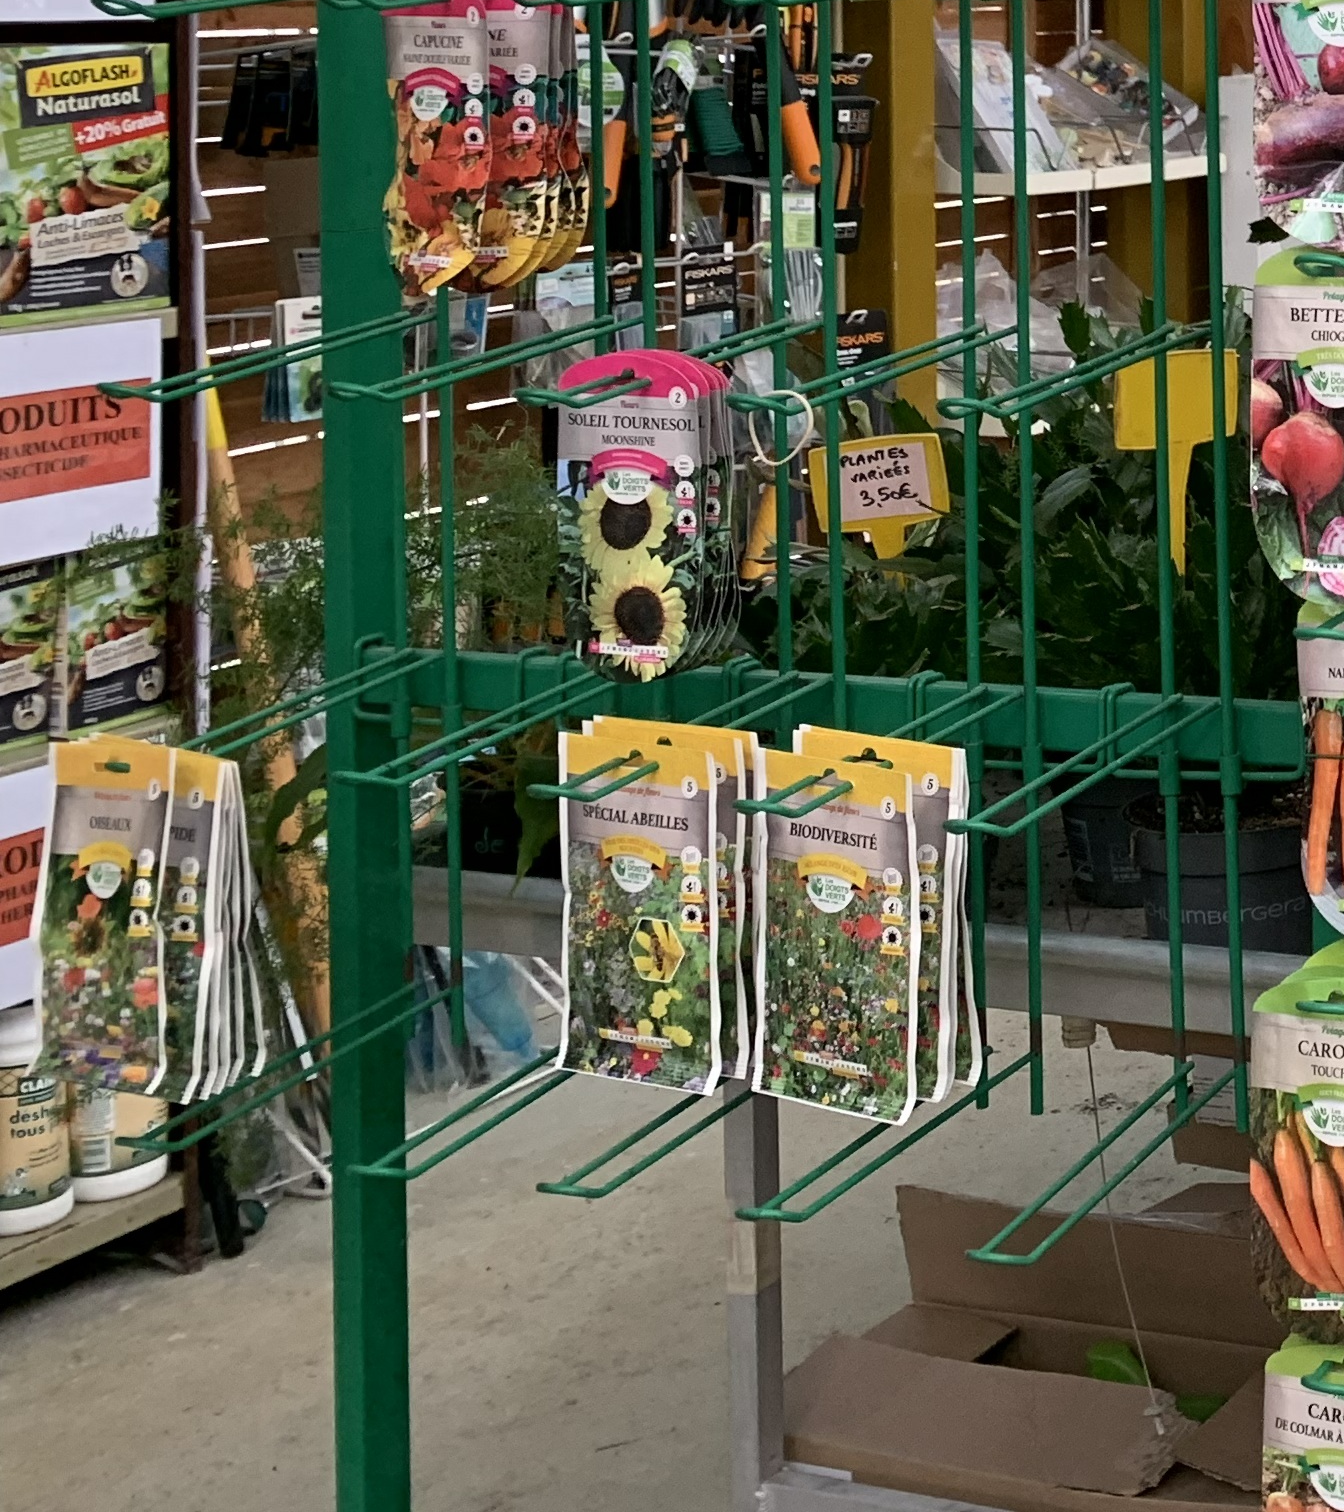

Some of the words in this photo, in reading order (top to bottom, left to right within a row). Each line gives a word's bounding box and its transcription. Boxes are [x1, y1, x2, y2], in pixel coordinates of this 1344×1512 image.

[414, 34, 463, 48] CAPUCINE
[38, 65, 129, 88] ALGOFLASH
[37, 86, 141, 116] Naturasol
[73, 120, 123, 144] +20%
[118, 111, 166, 135] Gratuit
[37, 211, 124, 237] Anti-Limaces
[685, 265, 734, 279] FISKARS
[567, 413, 609, 427] SOLEIL
[613, 416, 695, 432] TOURNESOL
[602, 435, 655, 446] MOONSHINE
[840, 447, 908, 468] PLANTES
[860, 483, 918, 508] 3,50€
[687, 782, 692, 792] 5
[89, 816, 131, 831] OISEAUX
[580, 804, 628, 823] SPÉCIAL
[631, 812, 688, 831] ABEILLES
[790, 822, 877, 850] BIODIVERSITÉ
[10, 1125, 45, 1138] tous
